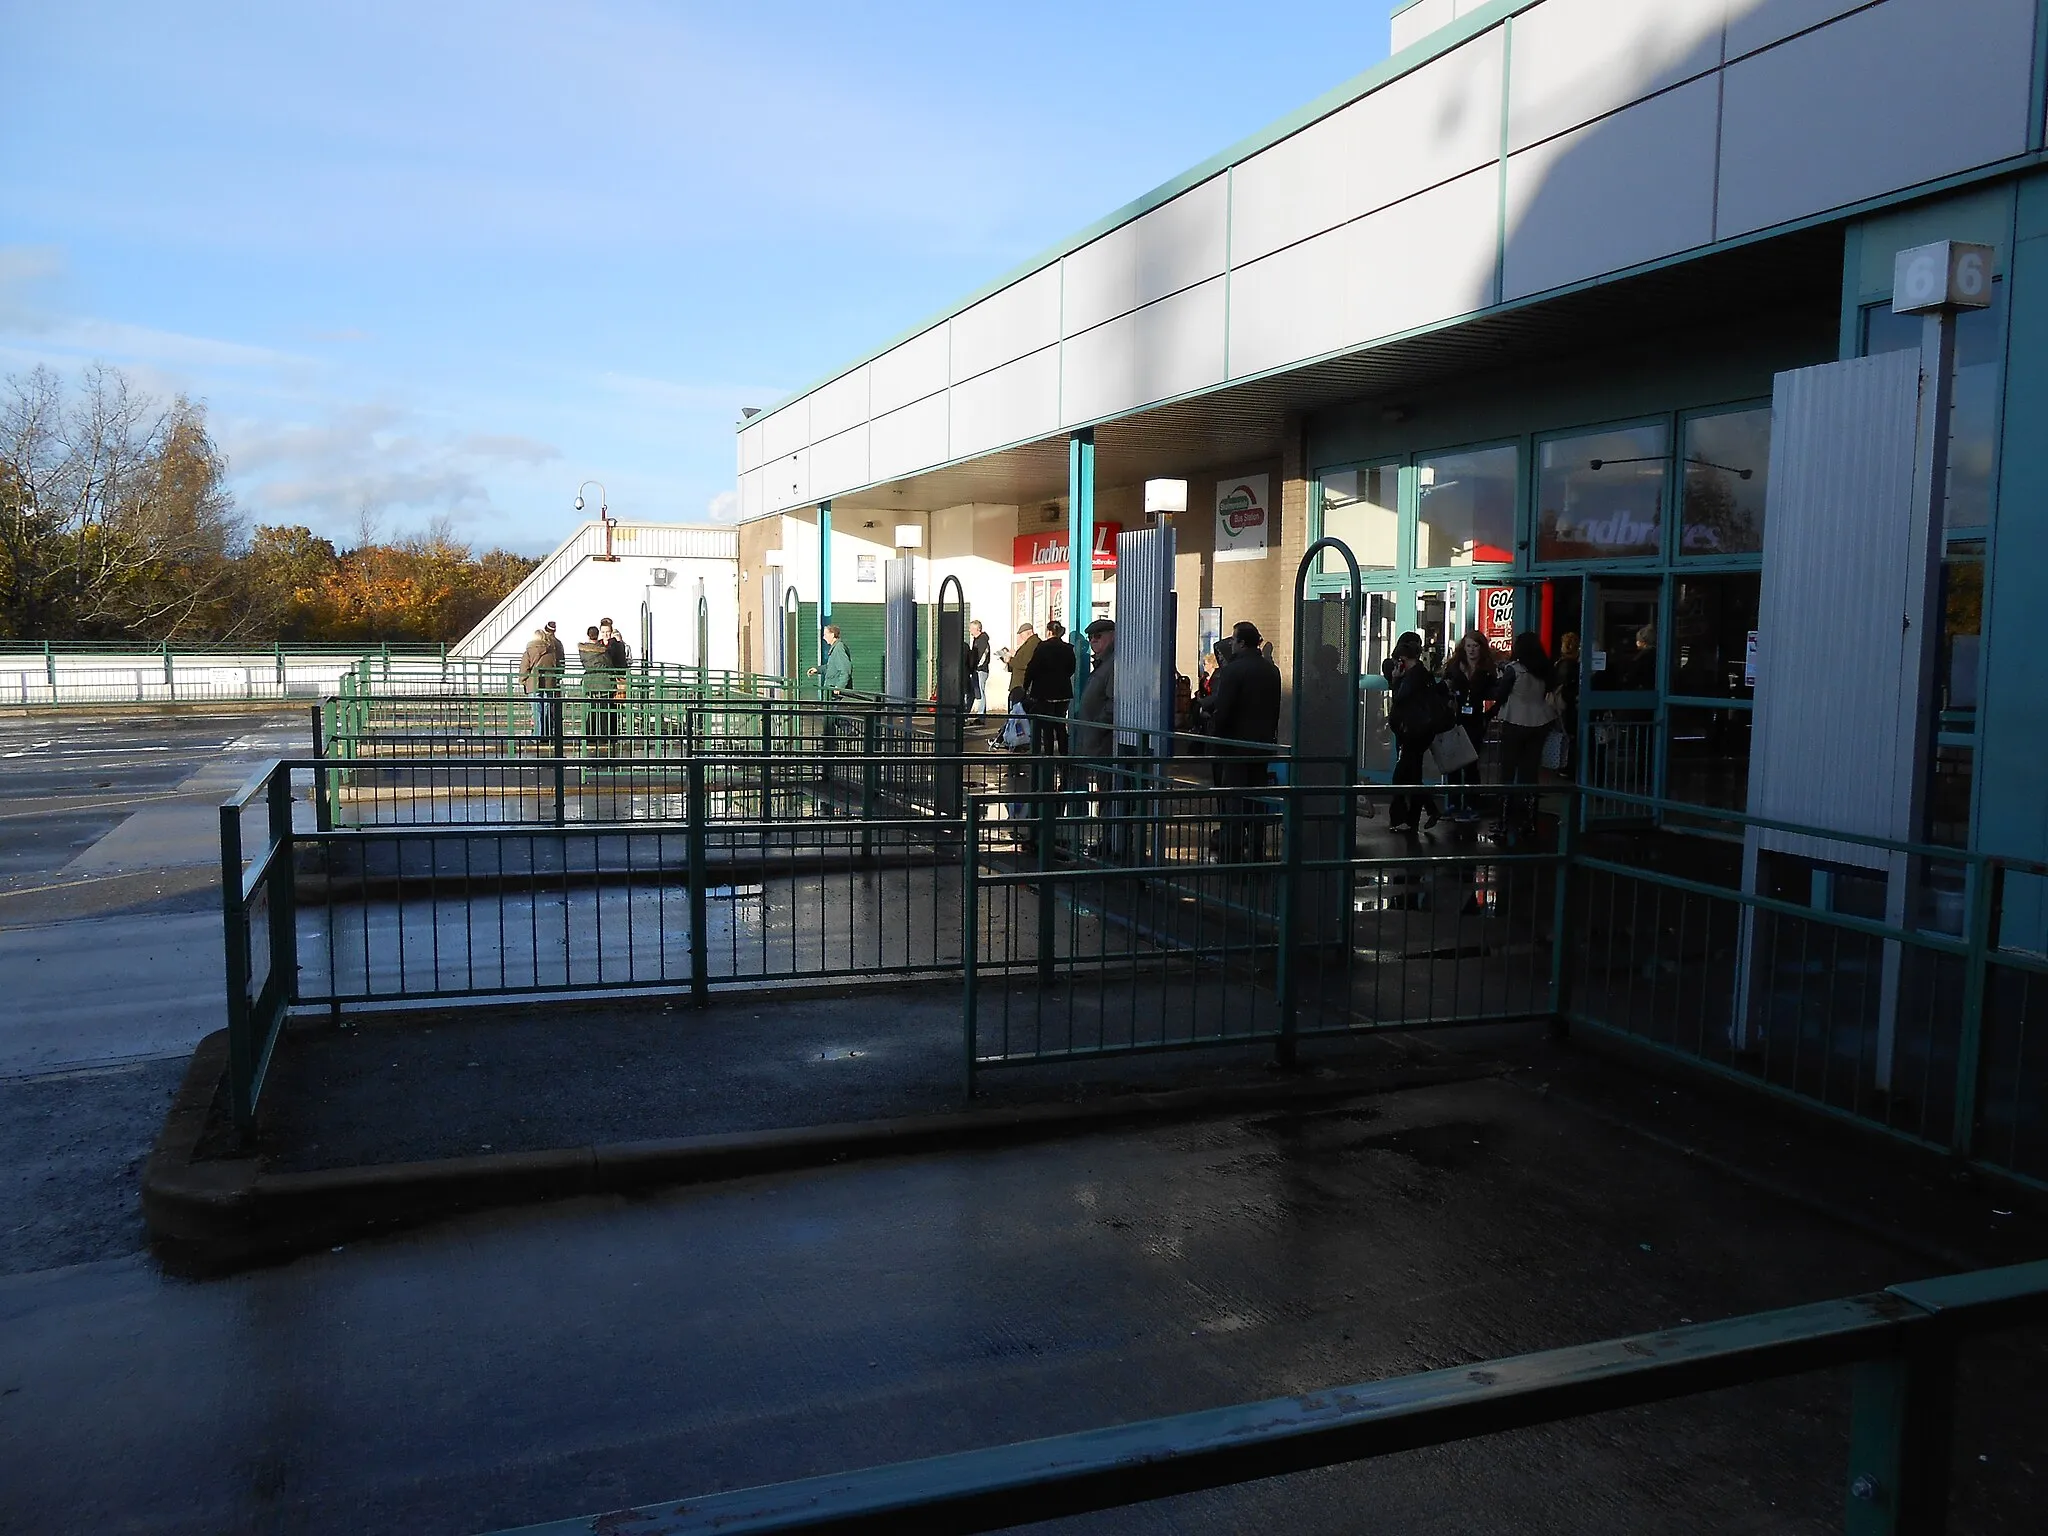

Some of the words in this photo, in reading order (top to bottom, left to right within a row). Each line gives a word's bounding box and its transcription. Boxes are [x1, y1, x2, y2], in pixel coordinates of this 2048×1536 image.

[1905, 255, 1935, 299] 6
[1957, 252, 1983, 296] 6
[1094, 527, 1110, 555] L
